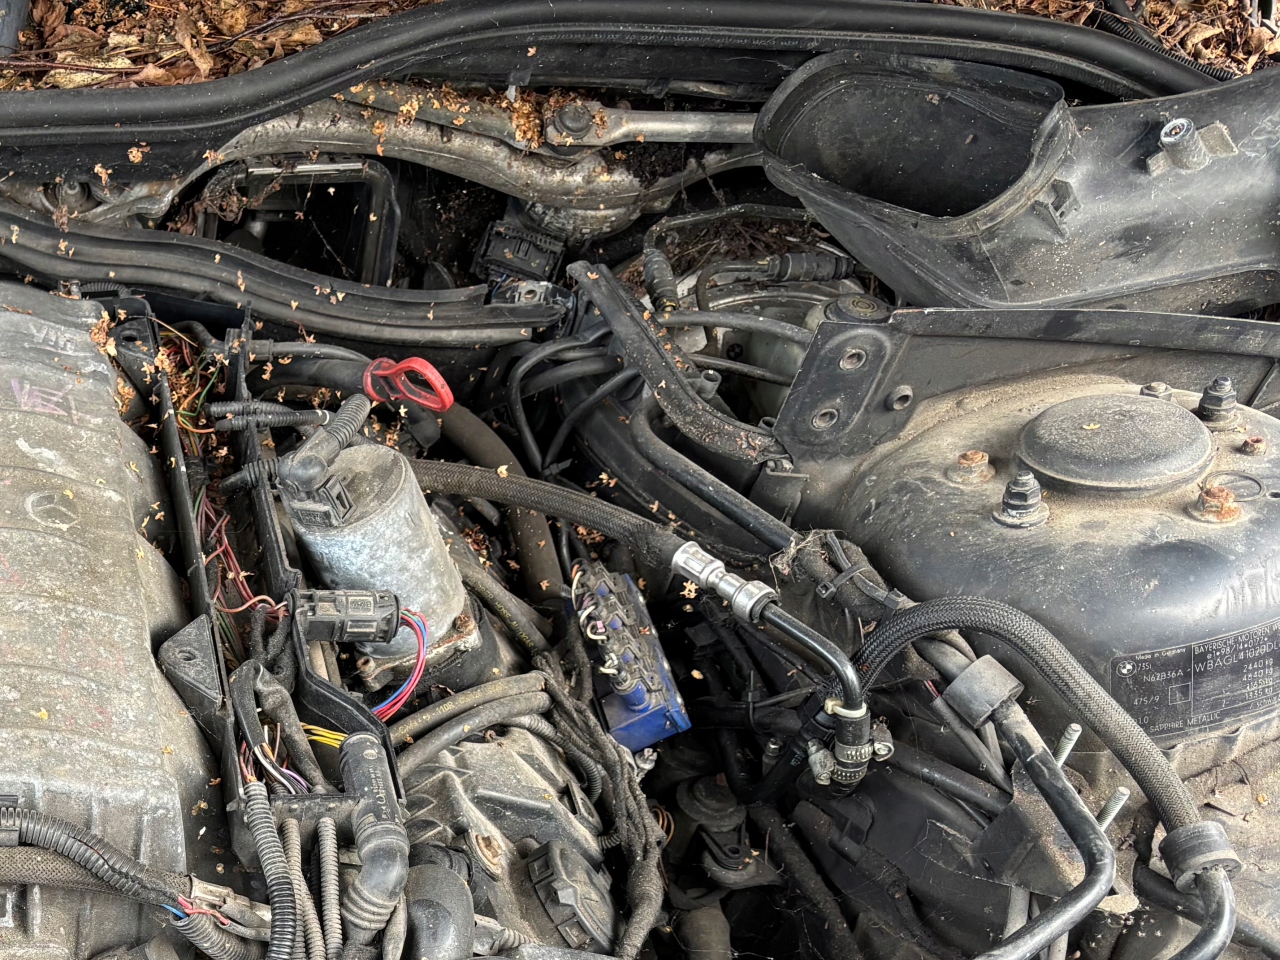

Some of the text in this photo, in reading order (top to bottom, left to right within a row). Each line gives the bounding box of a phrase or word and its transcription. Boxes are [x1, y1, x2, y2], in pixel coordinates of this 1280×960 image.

[495, 601, 511, 618] HOSE
[1243, 659, 1264, 673] 2440
[1149, 711, 1220, 733] SAPPHIRE METALLIC
